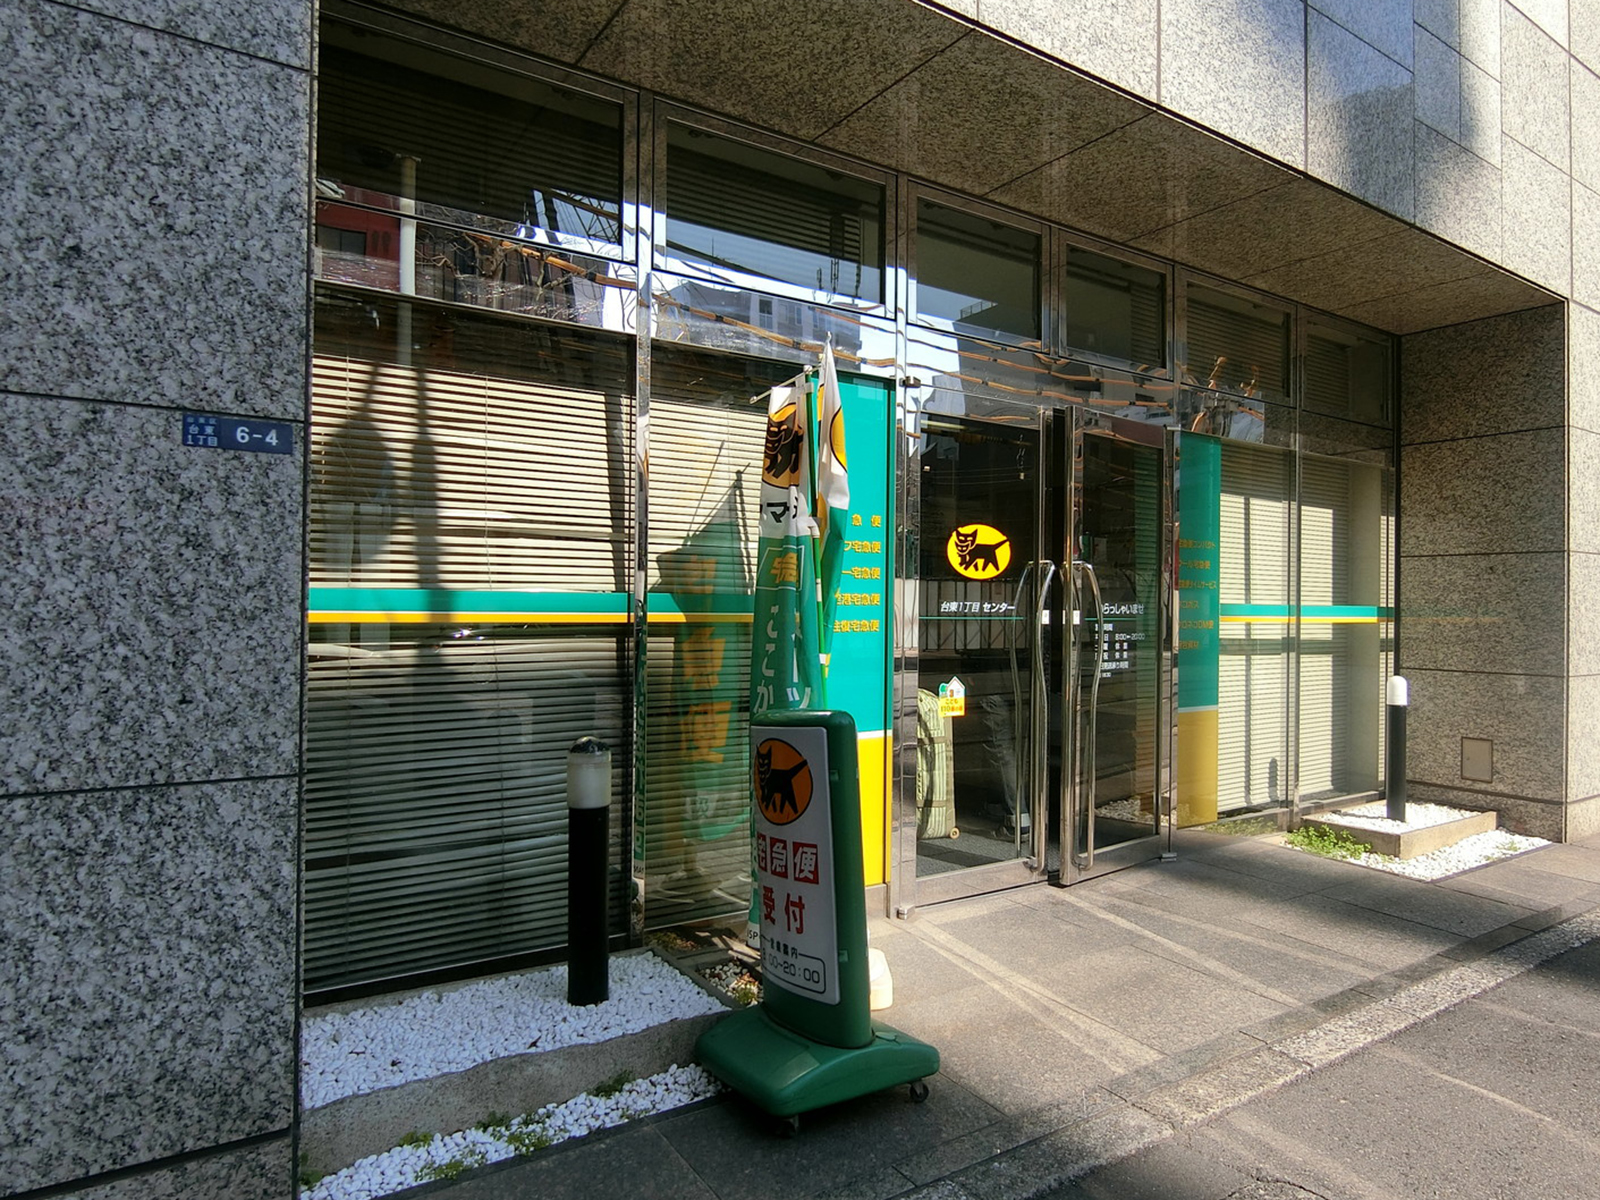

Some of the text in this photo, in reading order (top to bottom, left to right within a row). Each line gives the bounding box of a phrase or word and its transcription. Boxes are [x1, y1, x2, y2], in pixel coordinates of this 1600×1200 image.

[186, 434, 218, 447] 1丁目
[236, 426, 279, 446] 6-4
[940, 601, 1015, 613] 台東1丁目 センター
[763, 885, 805, 934] 受付
